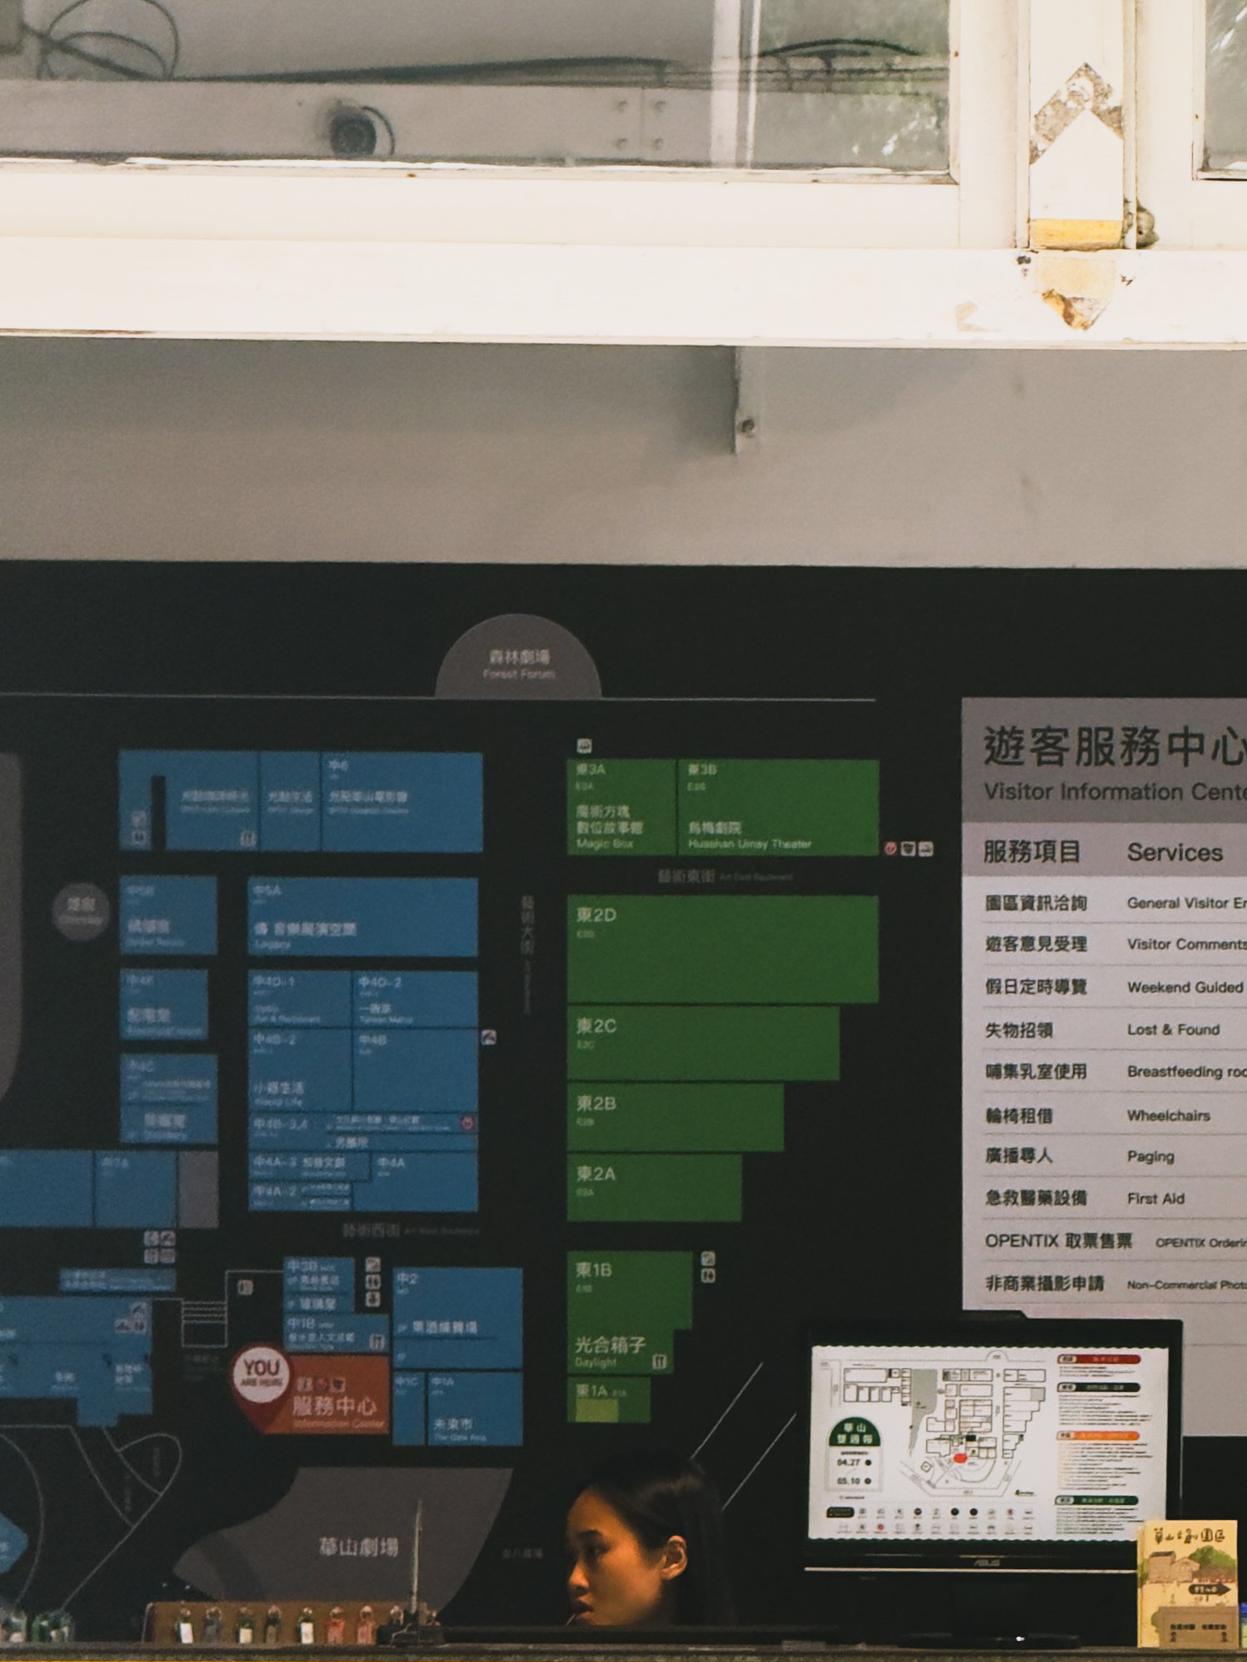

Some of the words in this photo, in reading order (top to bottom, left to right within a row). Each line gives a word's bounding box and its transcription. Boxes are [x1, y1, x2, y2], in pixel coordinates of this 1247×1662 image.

[984, 782, 1053, 801] Visitor
[1061, 782, 1183, 801] Information
[984, 840, 1081, 863] 服務項目
[1127, 842, 1224, 862] Services
[985, 894, 1088, 912] 園區資訊洽詢
[1127, 897, 1180, 910] General
[1184, 897, 1229, 910] Visitor
[576, 907, 617, 923] 東2D
[985, 935, 1088, 953] 遊客意見受理
[1127, 938, 1172, 951] Visitor
[985, 978, 1088, 996] 假日定時導覽
[1127, 981, 1190, 995] Weekend
[1194, 981, 1244, 995] Guided
[576, 1018, 617, 1034] 東2C
[985, 1021, 1054, 1039] 失物招領
[1127, 1023, 1158, 1037] Lost
[1162, 1023, 1173, 1037] &
[1177, 1023, 1220, 1037] Found
[985, 1063, 1088, 1080] 哺集乳室使用
[1127, 1064, 1223, 1080] Breastfeeding
[576, 1094, 617, 1111] 東2B
[985, 1107, 1054, 1125] 輪椅租借
[1127, 1109, 1211, 1123] Wheelchairs
[985, 1146, 1054, 1164] 廣播尋人
[1127, 1150, 1175, 1166] Paging
[576, 1165, 617, 1182] 東2A
[985, 1189, 1088, 1207] 急救醫藥設備
[1127, 1192, 1158, 1206] First
[1162, 1192, 1185, 1206] Aid
[985, 1234, 1059, 1248] OPENTIX
[1065, 1233, 1133, 1249] 取票售票
[1155, 1238, 1206, 1249] OPENTIX
[575, 1262, 612, 1278] 東1B
[985, 1275, 1104, 1292] 非商業攝影申請
[1127, 1280, 1217, 1291] Non-Commercial
[575, 1336, 647, 1354] 光合箱子
[244, 1360, 280, 1376] YOU
[575, 1356, 617, 1370] Daylight
[292, 1396, 378, 1417] 服務中心
[318, 1537, 399, 1557] 華山劇場
